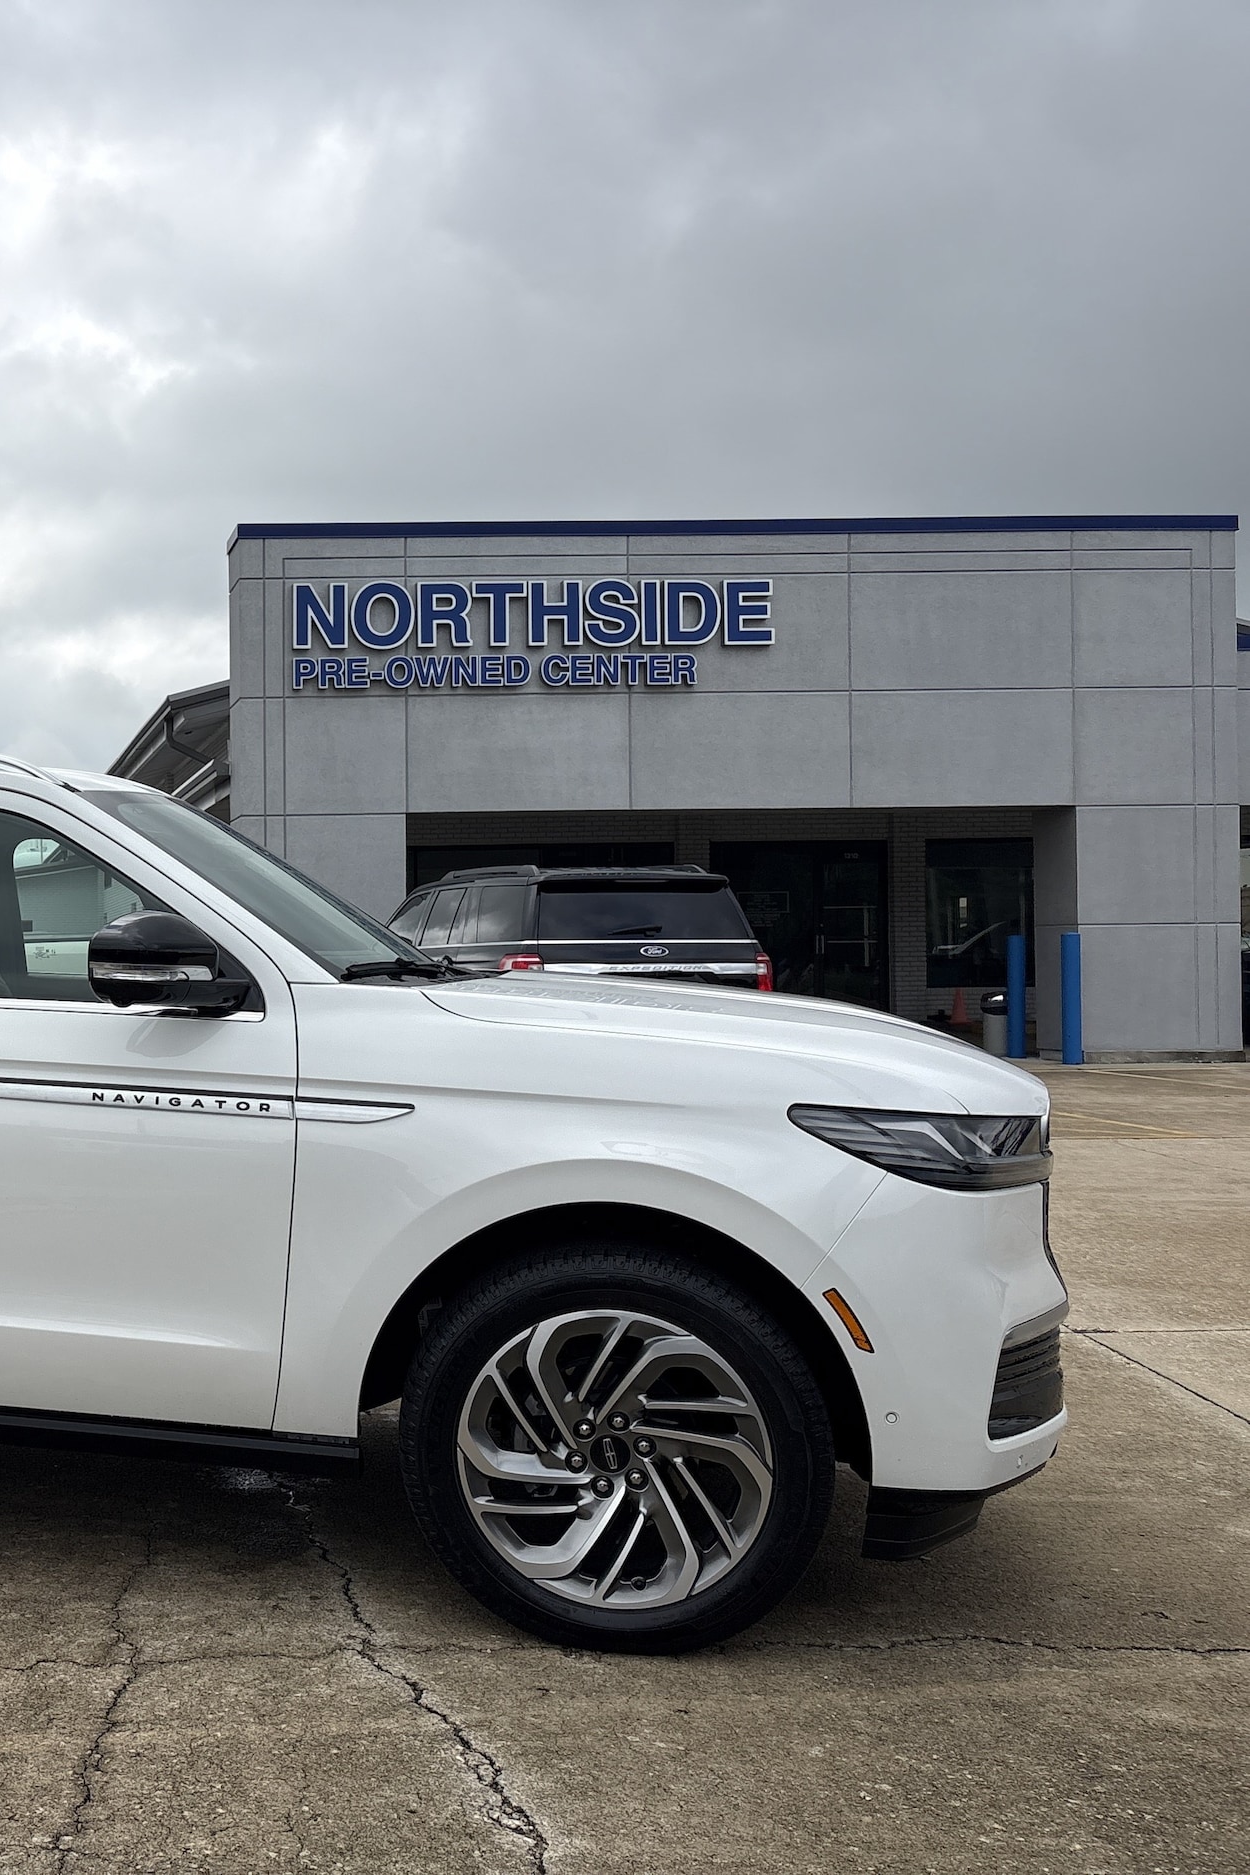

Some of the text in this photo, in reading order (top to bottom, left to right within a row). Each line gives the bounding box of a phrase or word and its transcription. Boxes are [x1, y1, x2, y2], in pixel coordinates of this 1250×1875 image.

[292, 579, 775, 651] NORTHSIDE
[292, 654, 698, 690] PRE-OWNED CENTER
[92, 1092, 271, 1113] NAVIGATOR
